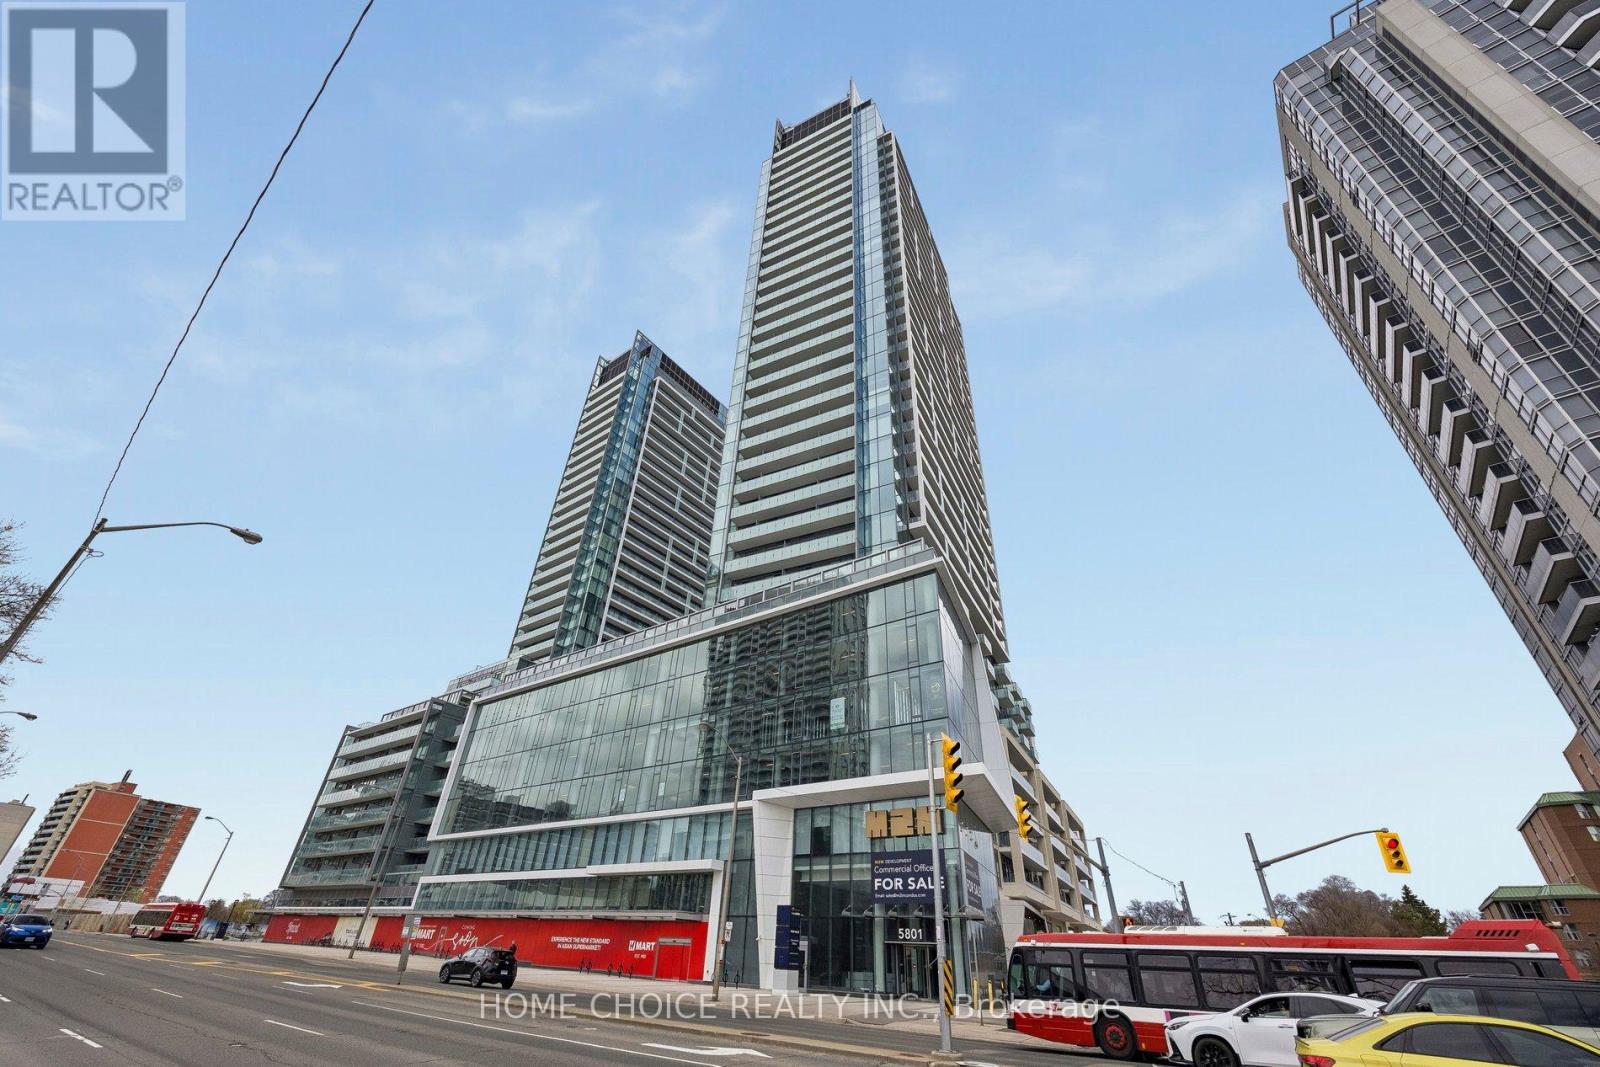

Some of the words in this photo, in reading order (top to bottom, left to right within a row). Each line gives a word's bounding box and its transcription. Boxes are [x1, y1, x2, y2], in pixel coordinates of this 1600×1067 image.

[874, 865, 912, 874] Commercial
[874, 877, 903, 891] FOR
[907, 876, 945, 890] SALE
[898, 928, 923, 940] 5801
[635, 941, 656, 951] MART
